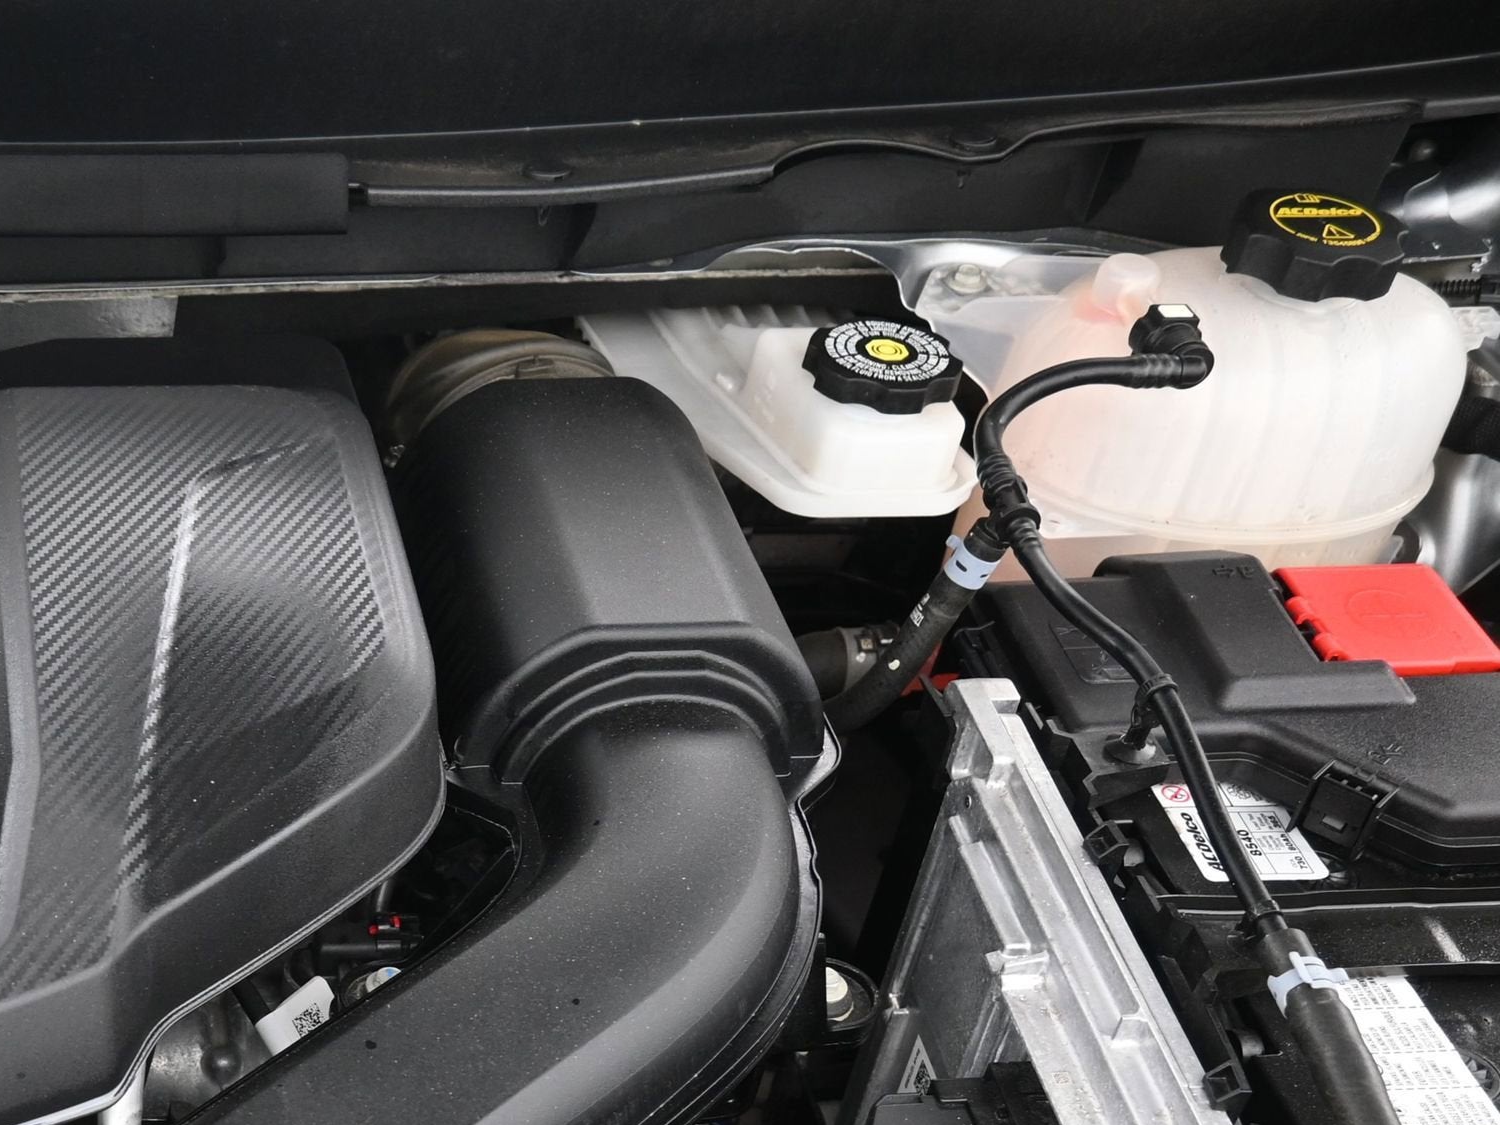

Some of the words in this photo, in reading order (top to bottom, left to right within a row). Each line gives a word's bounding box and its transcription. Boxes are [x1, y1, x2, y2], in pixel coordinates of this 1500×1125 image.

[1276, 207, 1363, 217] ACDelco
[1180, 811, 1225, 872] ACDelco
[1237, 829, 1262, 857] 8540
[1294, 856, 1307, 868] 730
